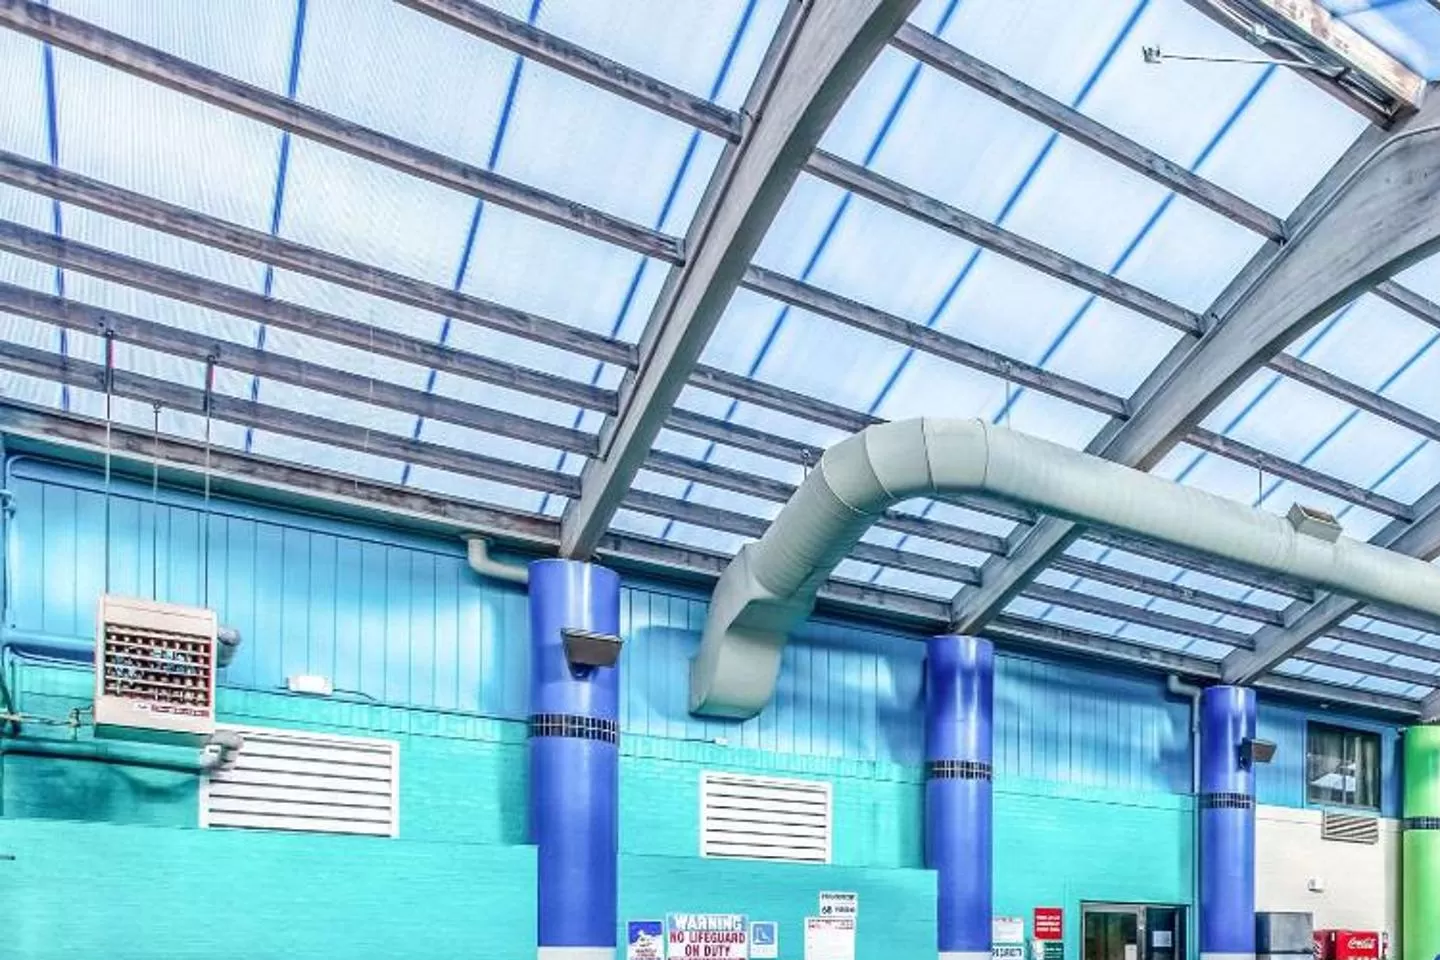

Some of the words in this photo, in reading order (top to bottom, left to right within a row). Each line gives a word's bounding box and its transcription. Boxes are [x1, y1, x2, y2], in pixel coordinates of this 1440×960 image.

[674, 913, 742, 931] WARNING
[669, 931, 685, 944] NO
[689, 931, 746, 944] LIFEGUARD
[685, 944, 700, 957] ON
[704, 944, 731, 957] DUTY
